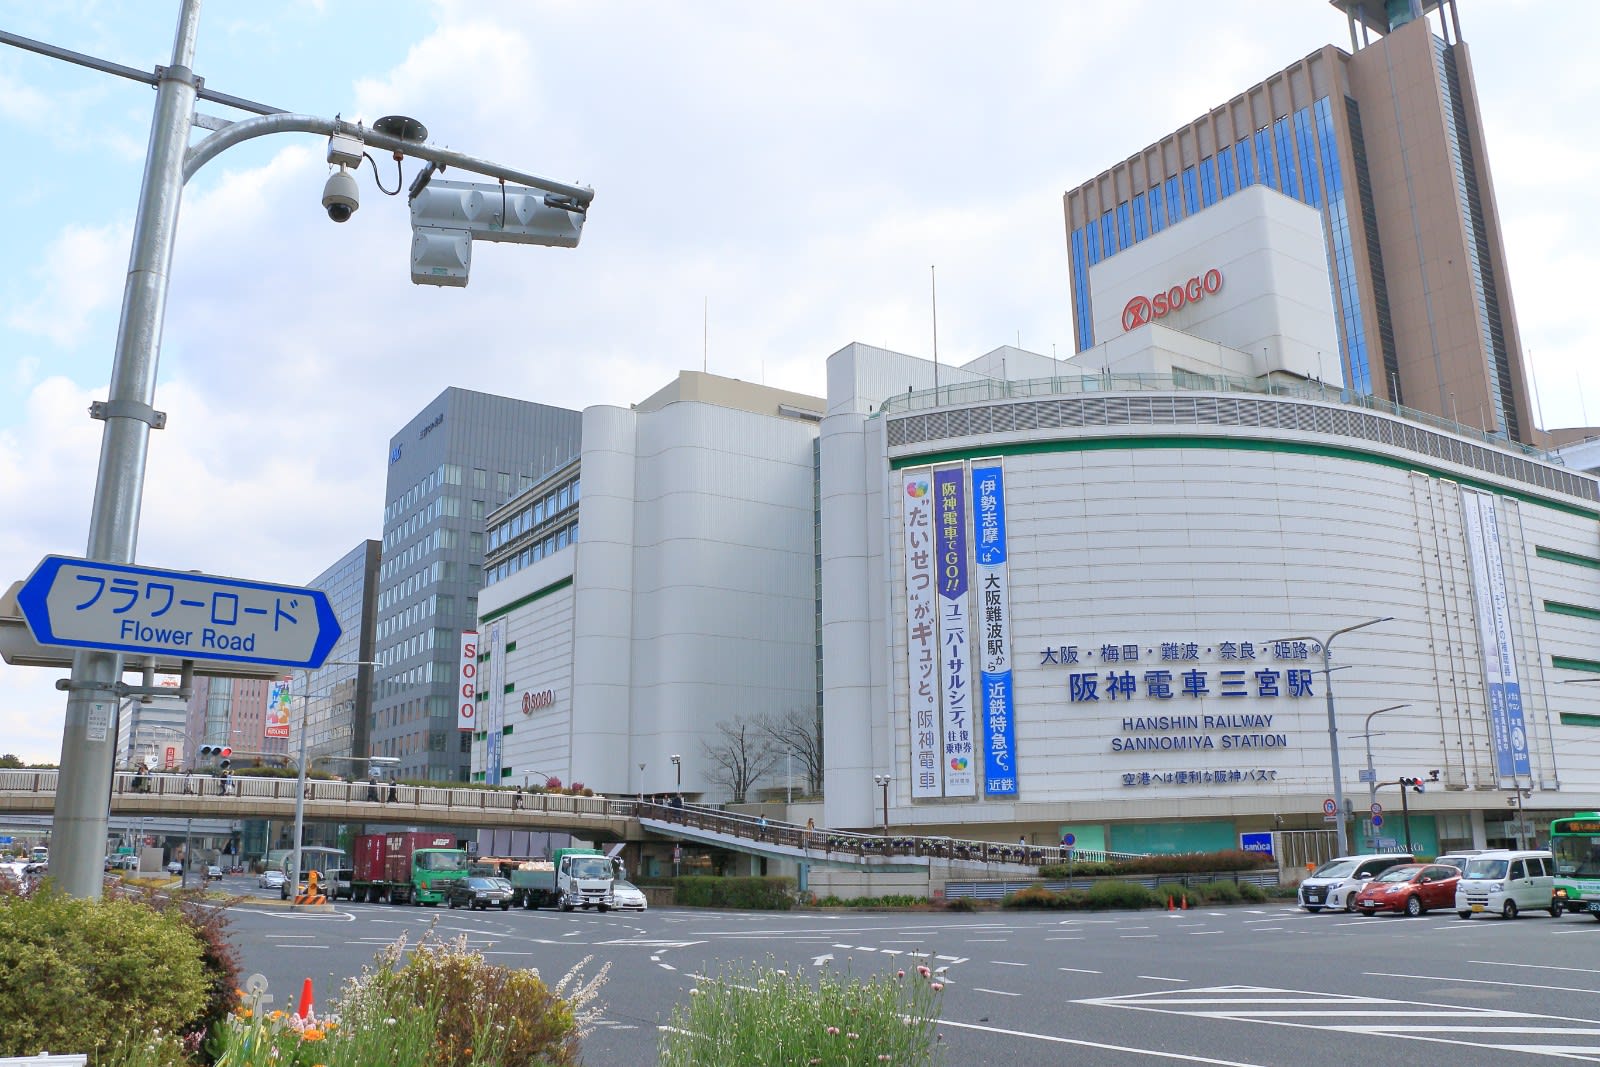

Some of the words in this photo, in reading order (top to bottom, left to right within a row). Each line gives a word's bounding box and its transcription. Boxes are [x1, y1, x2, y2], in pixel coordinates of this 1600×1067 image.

[1152, 268, 1223, 318] SOGO
[75, 574, 298, 632] フラワーロード
[985, 572, 1005, 672] 大阪難波駅から
[120, 620, 193, 647] Flower
[202, 628, 256, 652] Road
[461, 643, 476, 719] SOGO
[945, 604, 966, 729] ユニバーサルシティ
[1069, 668, 1314, 702] 阪神電車三宮駅
[988, 682, 1010, 772] 近鉄特急で。
[1111, 735, 1214, 752] SANNOMIYA
[1222, 734, 1287, 749] STATION
[1122, 716, 1198, 731] HANSHIN
[1204, 714, 1273, 729] RAILWAY
[917, 710, 936, 790] 阪神電車
[988, 778, 1014, 791] 近鉄
[1122, 769, 1277, 787] 空港へは便利な阪神バスで
